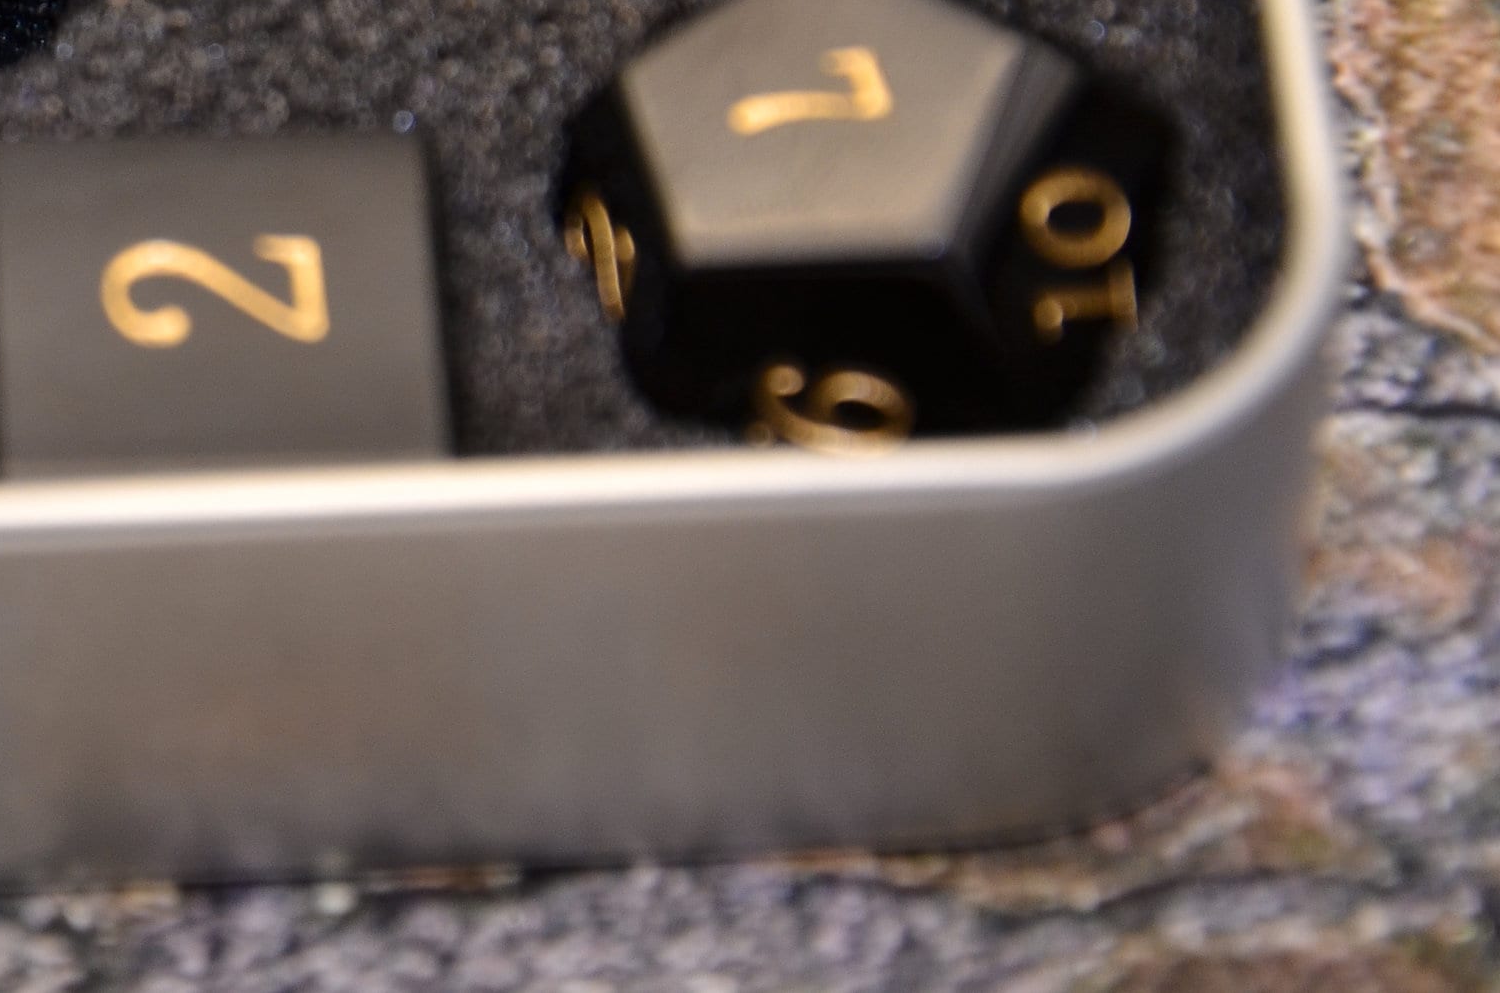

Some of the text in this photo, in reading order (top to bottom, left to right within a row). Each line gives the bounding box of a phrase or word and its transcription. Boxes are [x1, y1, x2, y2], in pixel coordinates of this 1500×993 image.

[726, 45, 893, 137] 7
[100, 233, 330, 349] 2
[1017, 165, 1138, 346] 10
